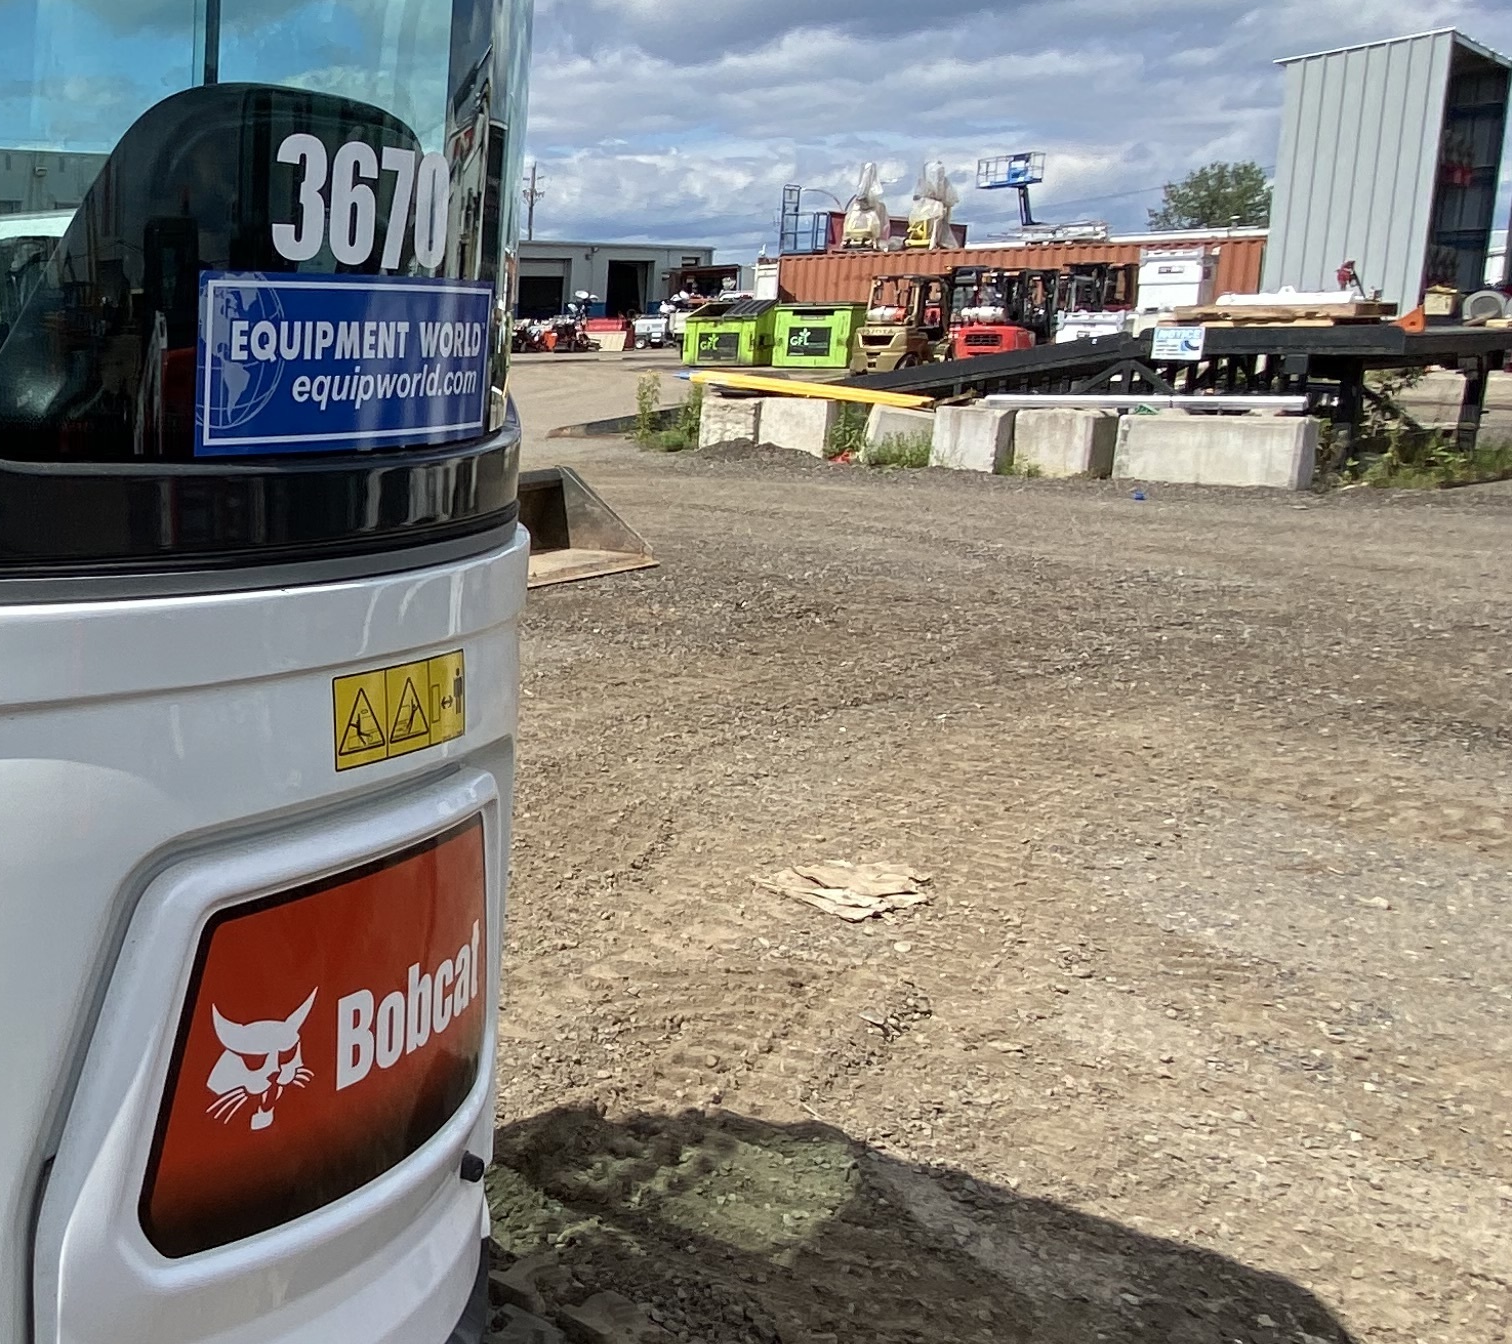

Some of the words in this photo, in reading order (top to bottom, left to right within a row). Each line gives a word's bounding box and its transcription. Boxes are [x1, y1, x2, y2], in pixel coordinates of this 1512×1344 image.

[271, 133, 450, 270] 3670
[230, 320, 410, 363] EQUIPMENT
[419, 321, 482, 358] WORLD
[700, 340, 718, 350] GFL
[790, 336, 809, 346] GFL
[292, 363, 477, 411] equipworld.com
[336, 919, 480, 1091] Bobcat
